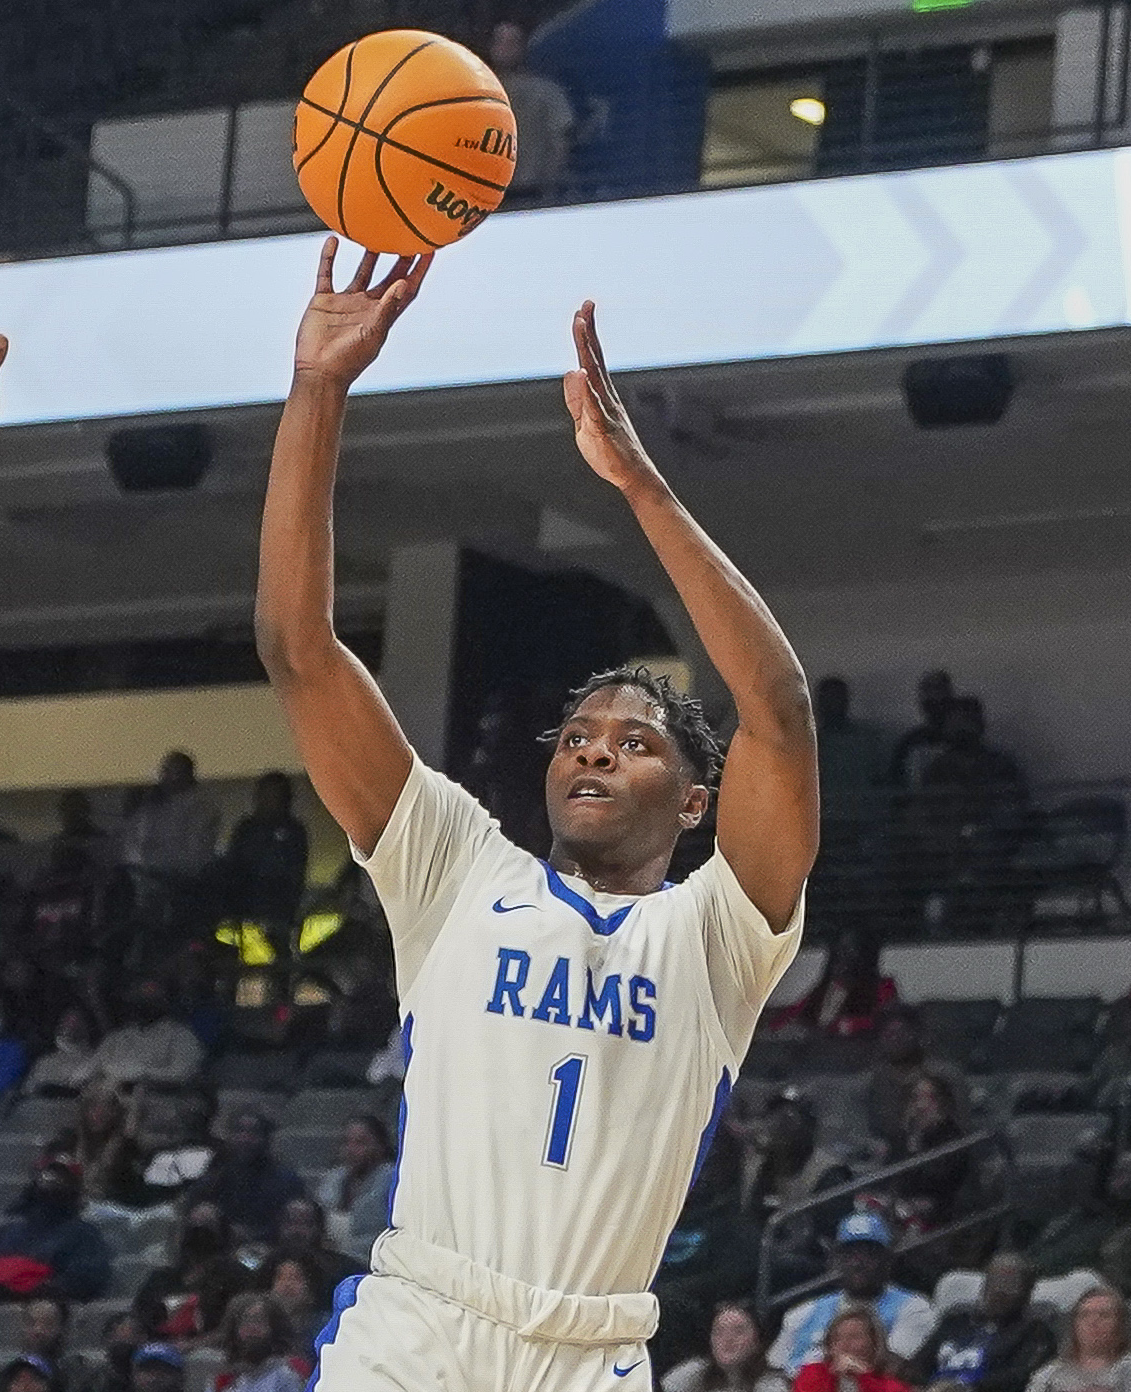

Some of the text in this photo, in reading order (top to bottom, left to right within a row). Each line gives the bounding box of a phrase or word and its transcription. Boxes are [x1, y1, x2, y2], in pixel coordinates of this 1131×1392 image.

[480, 128, 516, 162] VO
[425, 181, 490, 236] son
[485, 946, 658, 1044] RAMS
[541, 1052, 589, 1172] 1
